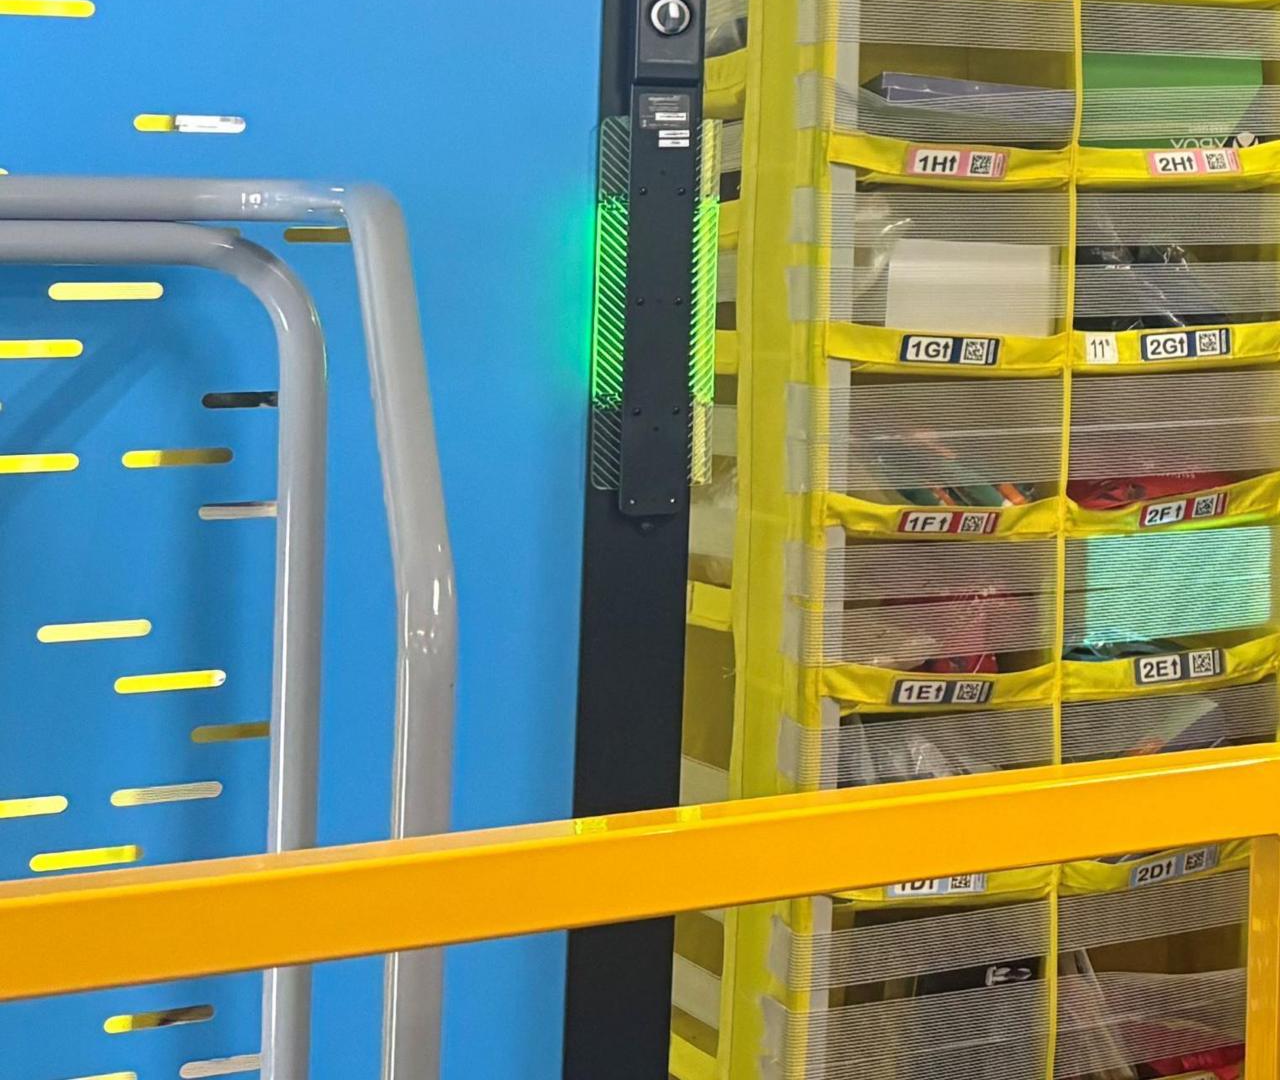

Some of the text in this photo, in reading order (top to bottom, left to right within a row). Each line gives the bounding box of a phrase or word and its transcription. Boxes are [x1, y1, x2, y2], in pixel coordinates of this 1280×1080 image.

[918, 156, 948, 171] 1H
[1159, 156, 1185, 171] 2H
[912, 341, 939, 357] 1G
[1150, 338, 1177, 354] 2G
[1148, 508, 1172, 523] 2F
[909, 516, 934, 531] 1F
[1143, 661, 1168, 678] 2E
[905, 684, 931, 699] 1E
[1138, 866, 1162, 881] 2D
